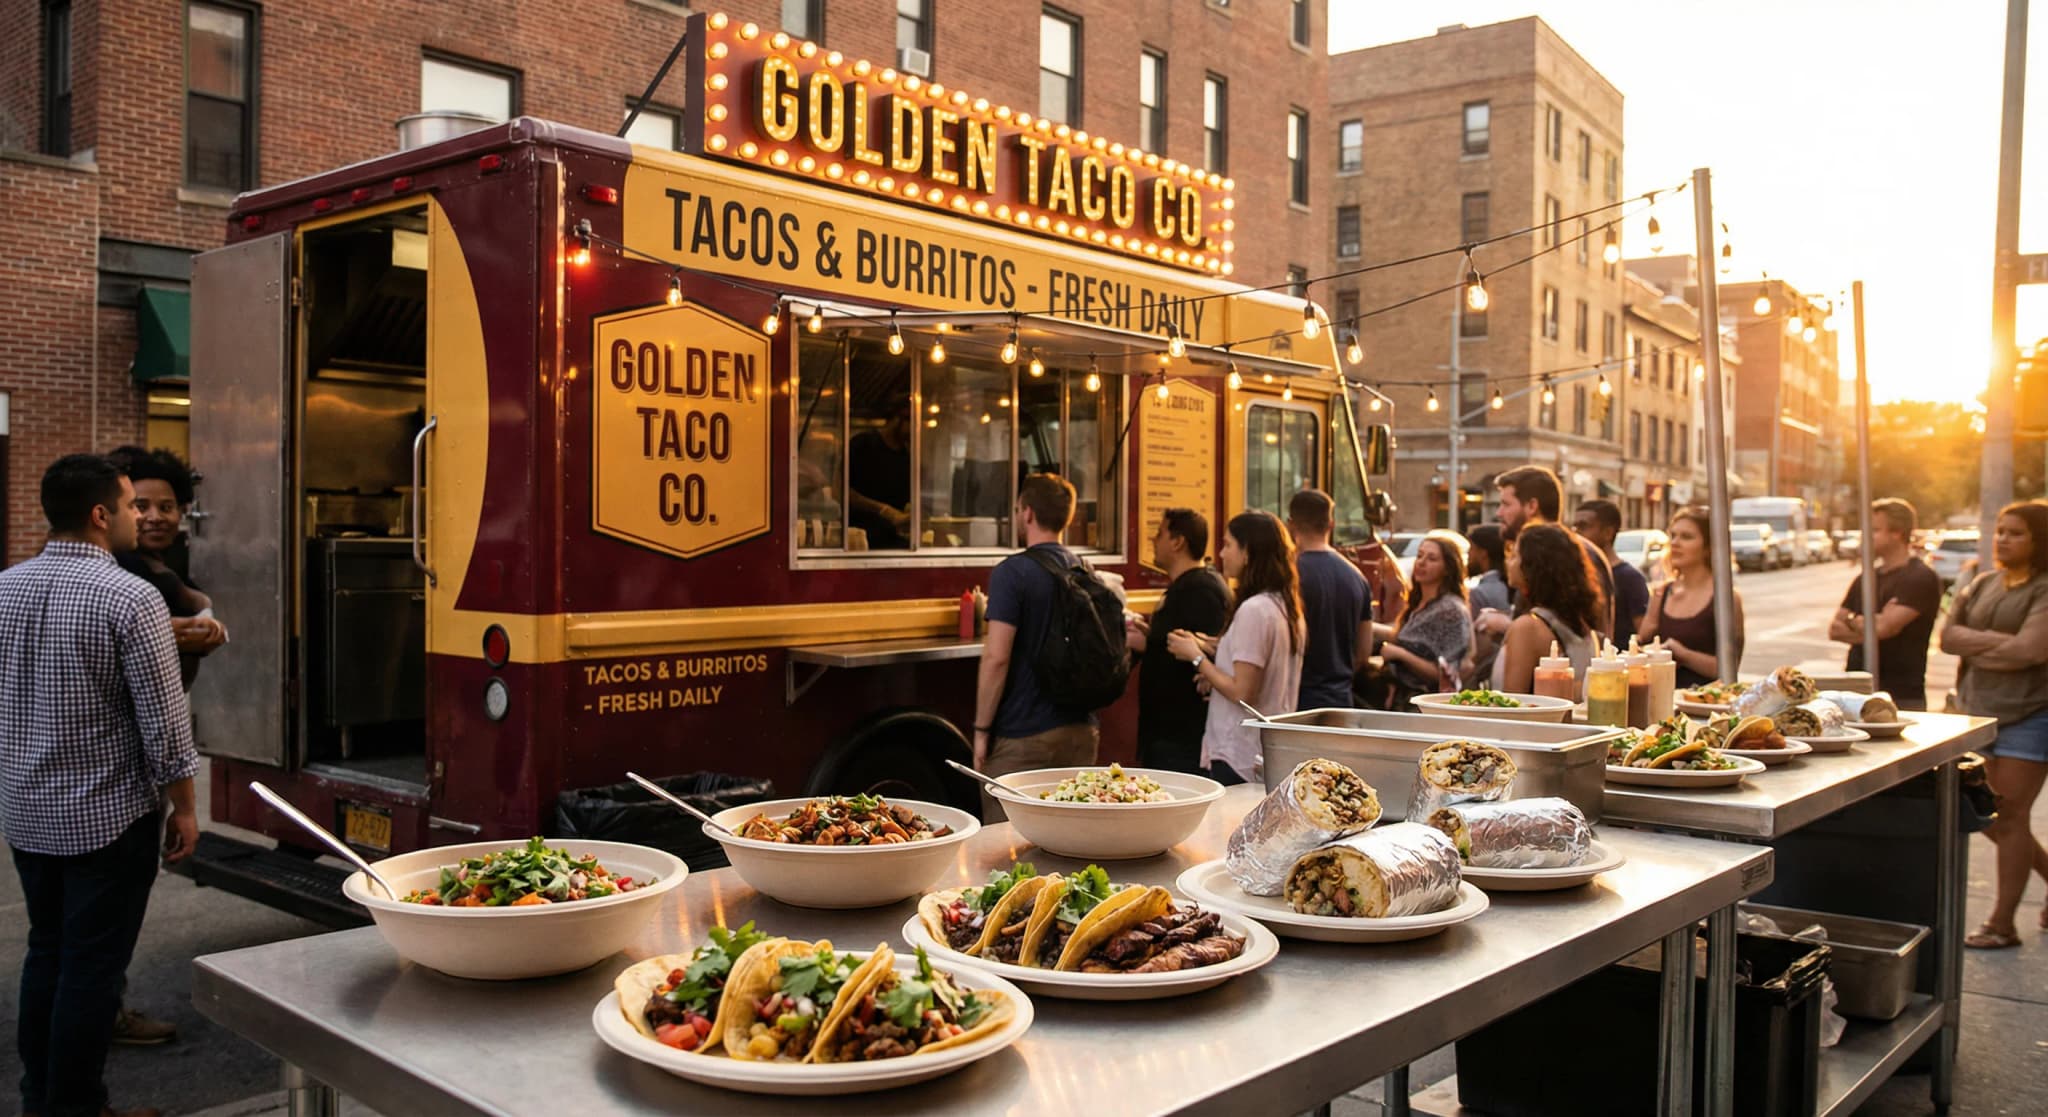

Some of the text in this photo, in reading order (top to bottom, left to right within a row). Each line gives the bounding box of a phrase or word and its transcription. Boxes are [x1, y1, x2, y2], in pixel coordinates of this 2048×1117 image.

[760, 55, 1214, 249] GOLDEN TACO CO.
[665, 188, 1205, 342] TACOS & BURRITOS - FRESH DAILY
[610, 338, 758, 403] GOLDEN
[636, 406, 733, 463] TACO
[658, 472, 719, 527] CO.
[584, 654, 768, 686] TACOS & BURRITOS
[584, 685, 723, 715] - FRESH DAILY
